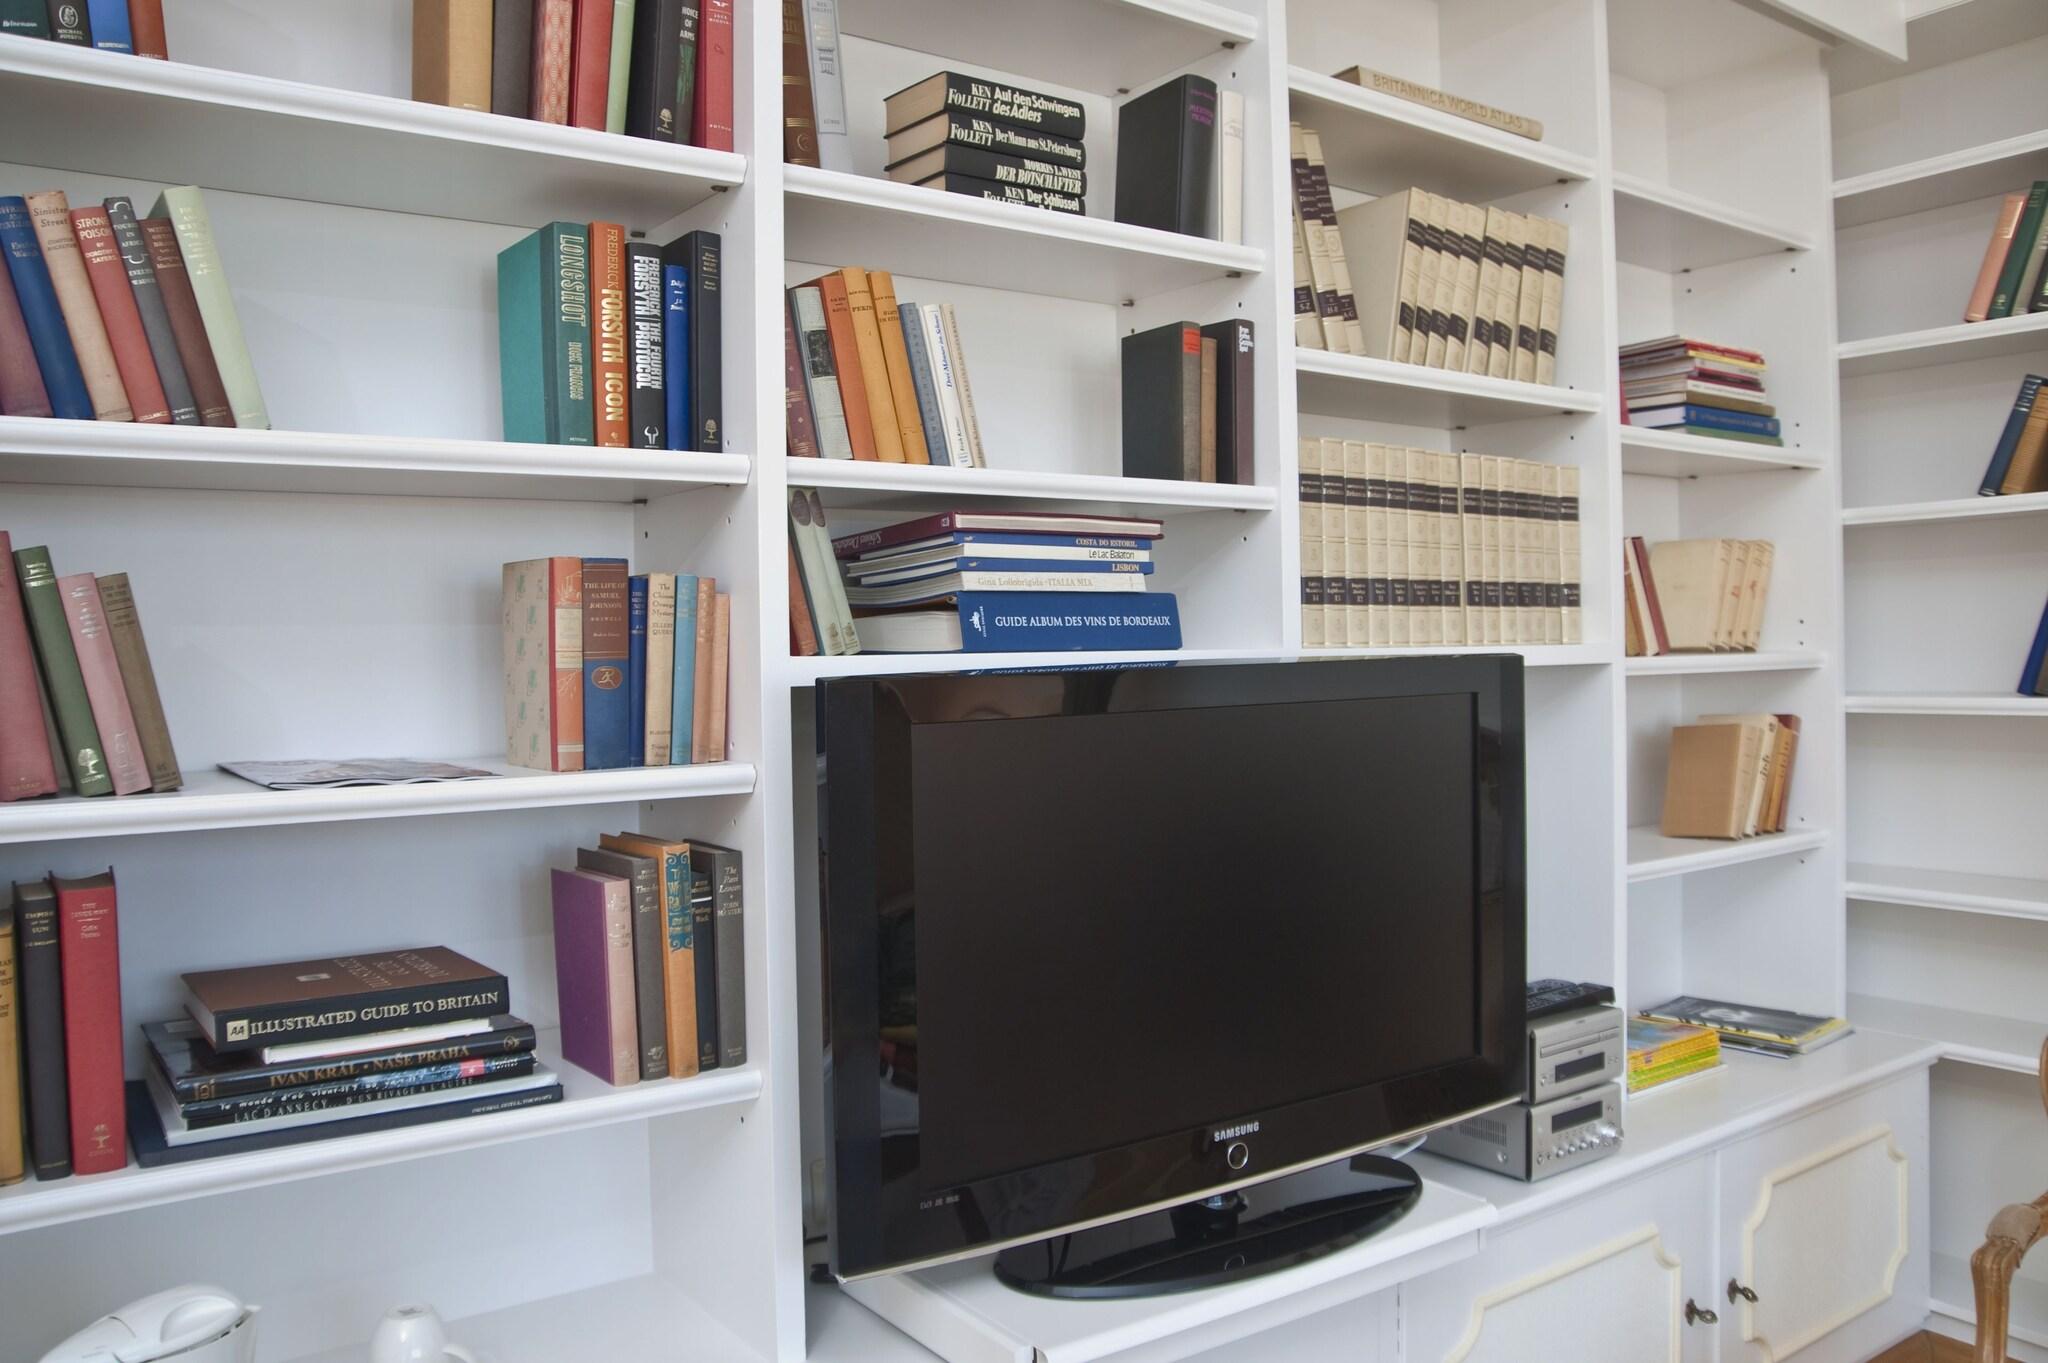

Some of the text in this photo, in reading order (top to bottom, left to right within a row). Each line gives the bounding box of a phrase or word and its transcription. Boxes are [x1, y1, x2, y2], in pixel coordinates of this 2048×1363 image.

[947, 88, 992, 112] FOLLETT
[970, 83, 991, 99] KEN
[993, 86, 1081, 118] Auf den Schwingen
[1372, 73, 1522, 130] BRITANNICA WORLD ATLAS
[992, 100, 1042, 123] des Adlers
[950, 123, 994, 147] FOLLETT
[972, 119, 993, 134] KEN
[995, 128, 1009, 144] Der
[1008, 131, 1027, 148] Mann
[995, 164, 1082, 195] DER BOTSCHAFTER
[1004, 186, 1025, 201] KEN
[1026, 188, 1043, 204] Der
[1043, 192, 1080, 212] Schlüssel
[607, 228, 619, 293] FREDERICK
[559, 233, 587, 328] LONGSHOT
[601, 288, 624, 364] FORSYTH
[633, 255, 652, 390] FORSYTH PROTOCOL
[648, 257, 663, 390] FREDERICK THE FOURTH
[604, 371, 624, 421] ICON
[1075, 538, 1098, 547] COSTA
[1109, 540, 1138, 549] ESTORIL
[1088, 550, 1135, 560] Le Lac Balaton
[1111, 563, 1140, 572] LISBON
[977, 577, 997, 587] Gina
[995, 616, 1172, 628] GUIDE ALBUM DES VINS DE BORDEAUX
[230, 991, 499, 1036] AA ILLUSTRATED GUIDE TO BRITAIN
[270, 1045, 470, 1088] IVAN KRÁL NAŠE PRAHA
[235, 1110, 258, 1123] LAC
[1213, 1121, 1260, 1142] SAMSUNG
